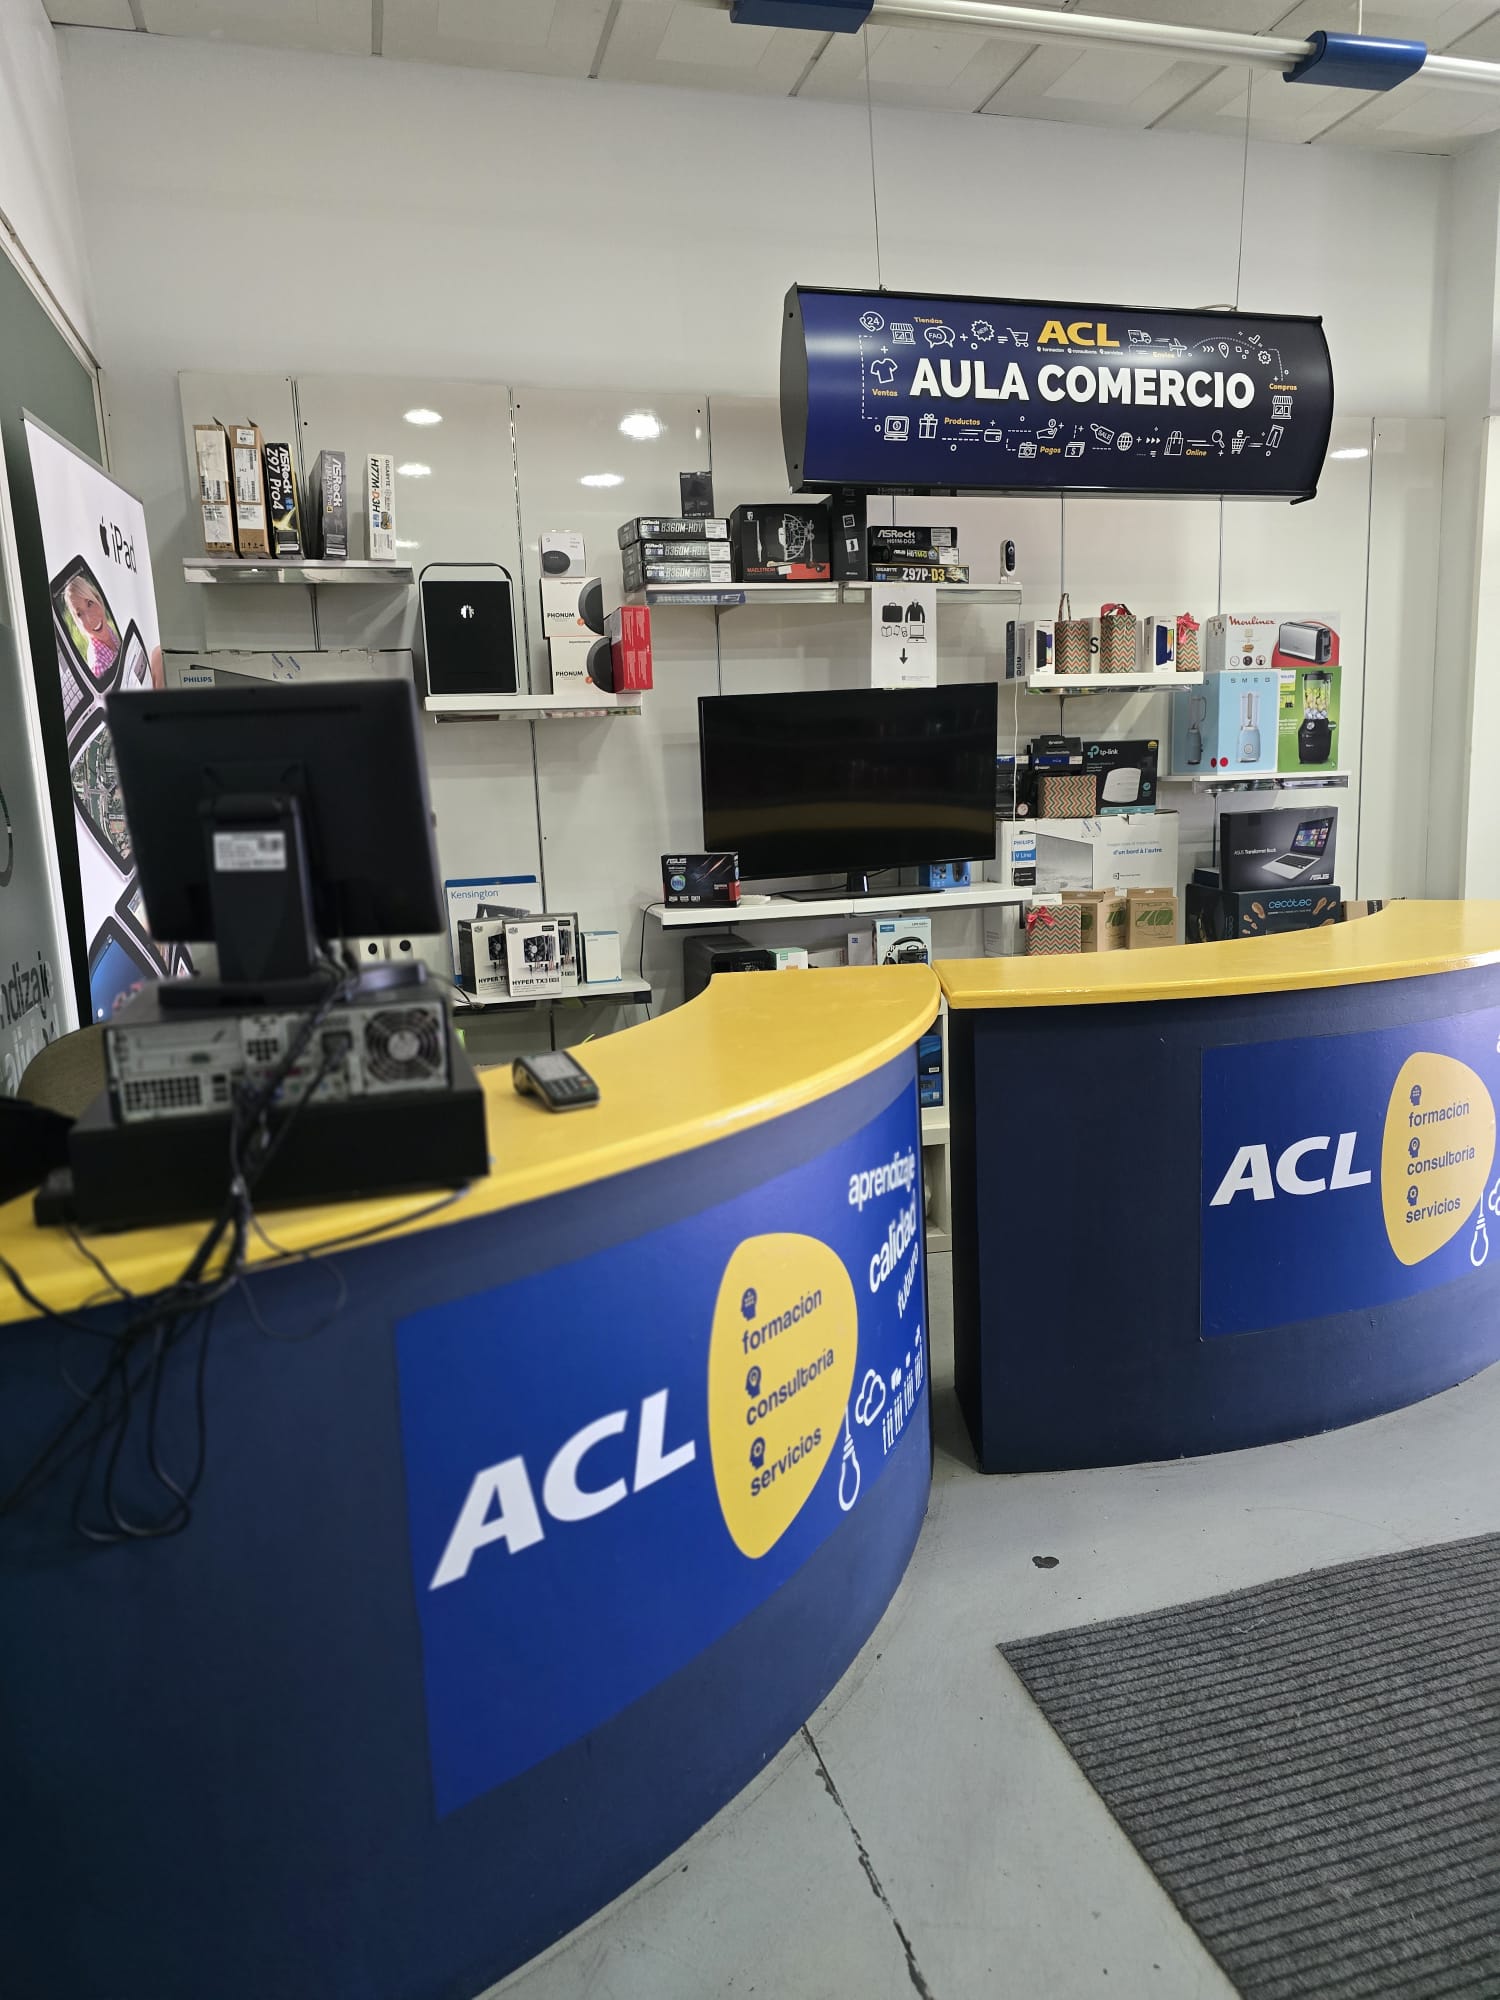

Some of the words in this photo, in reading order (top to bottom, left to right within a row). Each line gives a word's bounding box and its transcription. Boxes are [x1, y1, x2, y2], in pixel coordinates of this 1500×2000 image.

[914, 316, 943, 324] Tiendas
[928, 332, 942, 341] FAQ
[1037, 320, 1120, 347] ACL
[909, 357, 1029, 401] AULA
[1037, 363, 1256, 410] COMERCIO
[1269, 383, 1298, 391] Compras
[872, 388, 898, 397] Ventas
[944, 417, 981, 426] Productos
[1098, 429, 1111, 440] SALE
[1040, 446, 1061, 455] Pagos
[1185, 448, 1207, 456] Online
[266, 447, 281, 474] Z97
[279, 446, 293, 494] ASRock
[332, 458, 343, 508] ASRock
[370, 458, 381, 513] H77M-D3H
[269, 478, 285, 510] Pro4
[877, 529, 916, 538] ASRock
[110, 522, 138, 575] iPad
[902, 568, 946, 581] Z97P-D3
[1228, 615, 1276, 626] Moulinex
[183, 675, 213, 684] PHILIPS
[1100, 748, 1119, 756] tp-link
[1309, 873, 1330, 881] ASUS
[451, 889, 499, 900] Kensington
[1268, 898, 1313, 909] cecotec
[478, 976, 499, 984] HYPER
[512, 978, 534, 986] HYPER
[1408, 1098, 1471, 1128] formación
[1209, 1132, 1372, 1207] ACL
[849, 1146, 916, 1213] aprendizaje
[1405, 1196, 1462, 1224] servicios
[869, 1189, 917, 1293] calidad
[897, 1241, 919, 1319] futuro
[741, 1288, 823, 1355] formación
[750, 1427, 822, 1497] servicios
[428, 1388, 696, 1592] ACL
